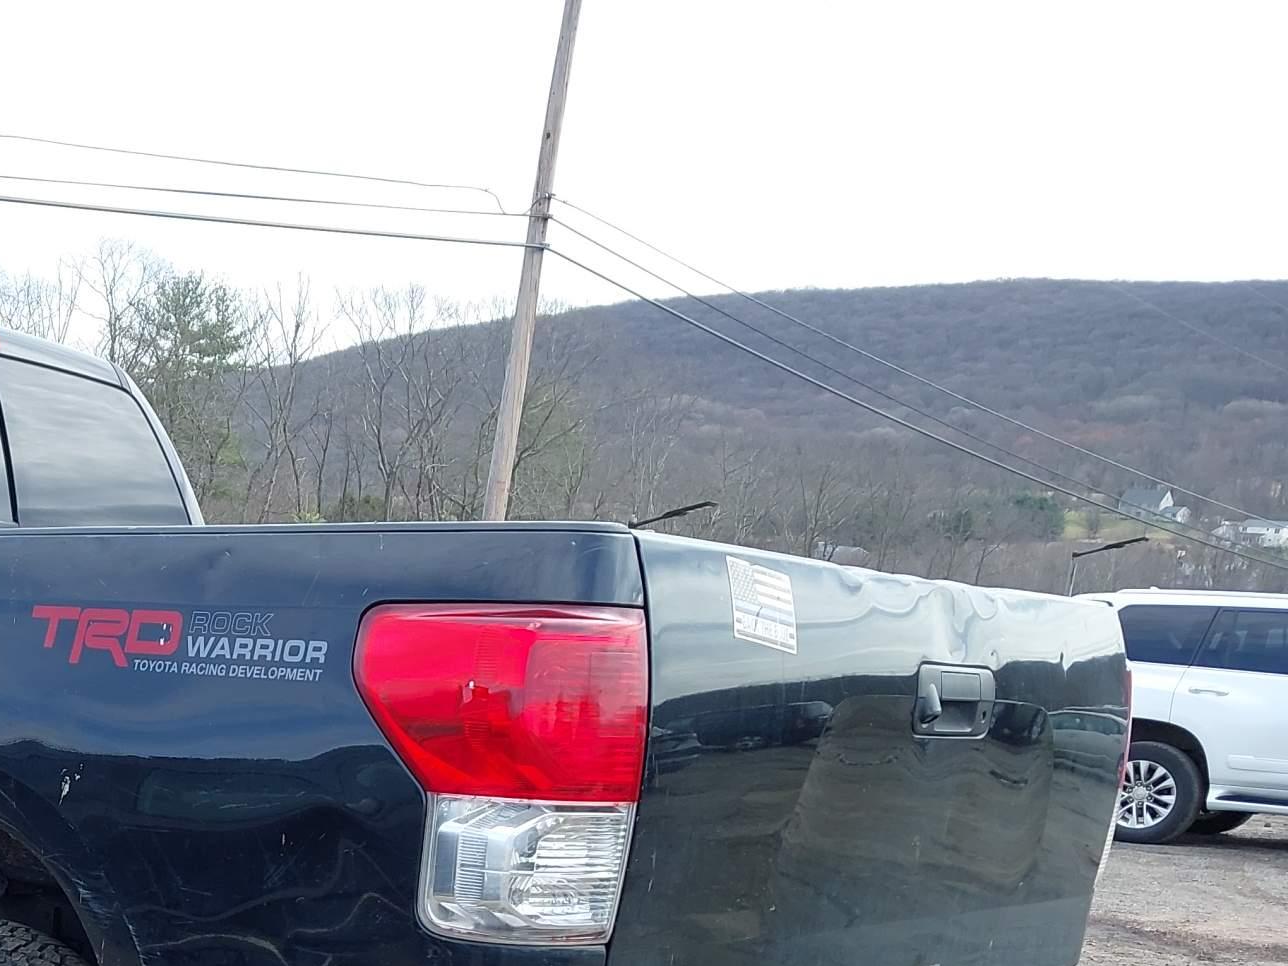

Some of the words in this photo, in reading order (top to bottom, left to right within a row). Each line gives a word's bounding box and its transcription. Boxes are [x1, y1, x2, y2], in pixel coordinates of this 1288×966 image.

[32, 605, 184, 667] TRD
[189, 611, 274, 636] ROCK
[187, 635, 328, 664] WARRIOR
[133, 659, 178, 673] TOYOTA
[181, 662, 227, 677] RACING
[229, 664, 323, 681] DEVELOPMENT
